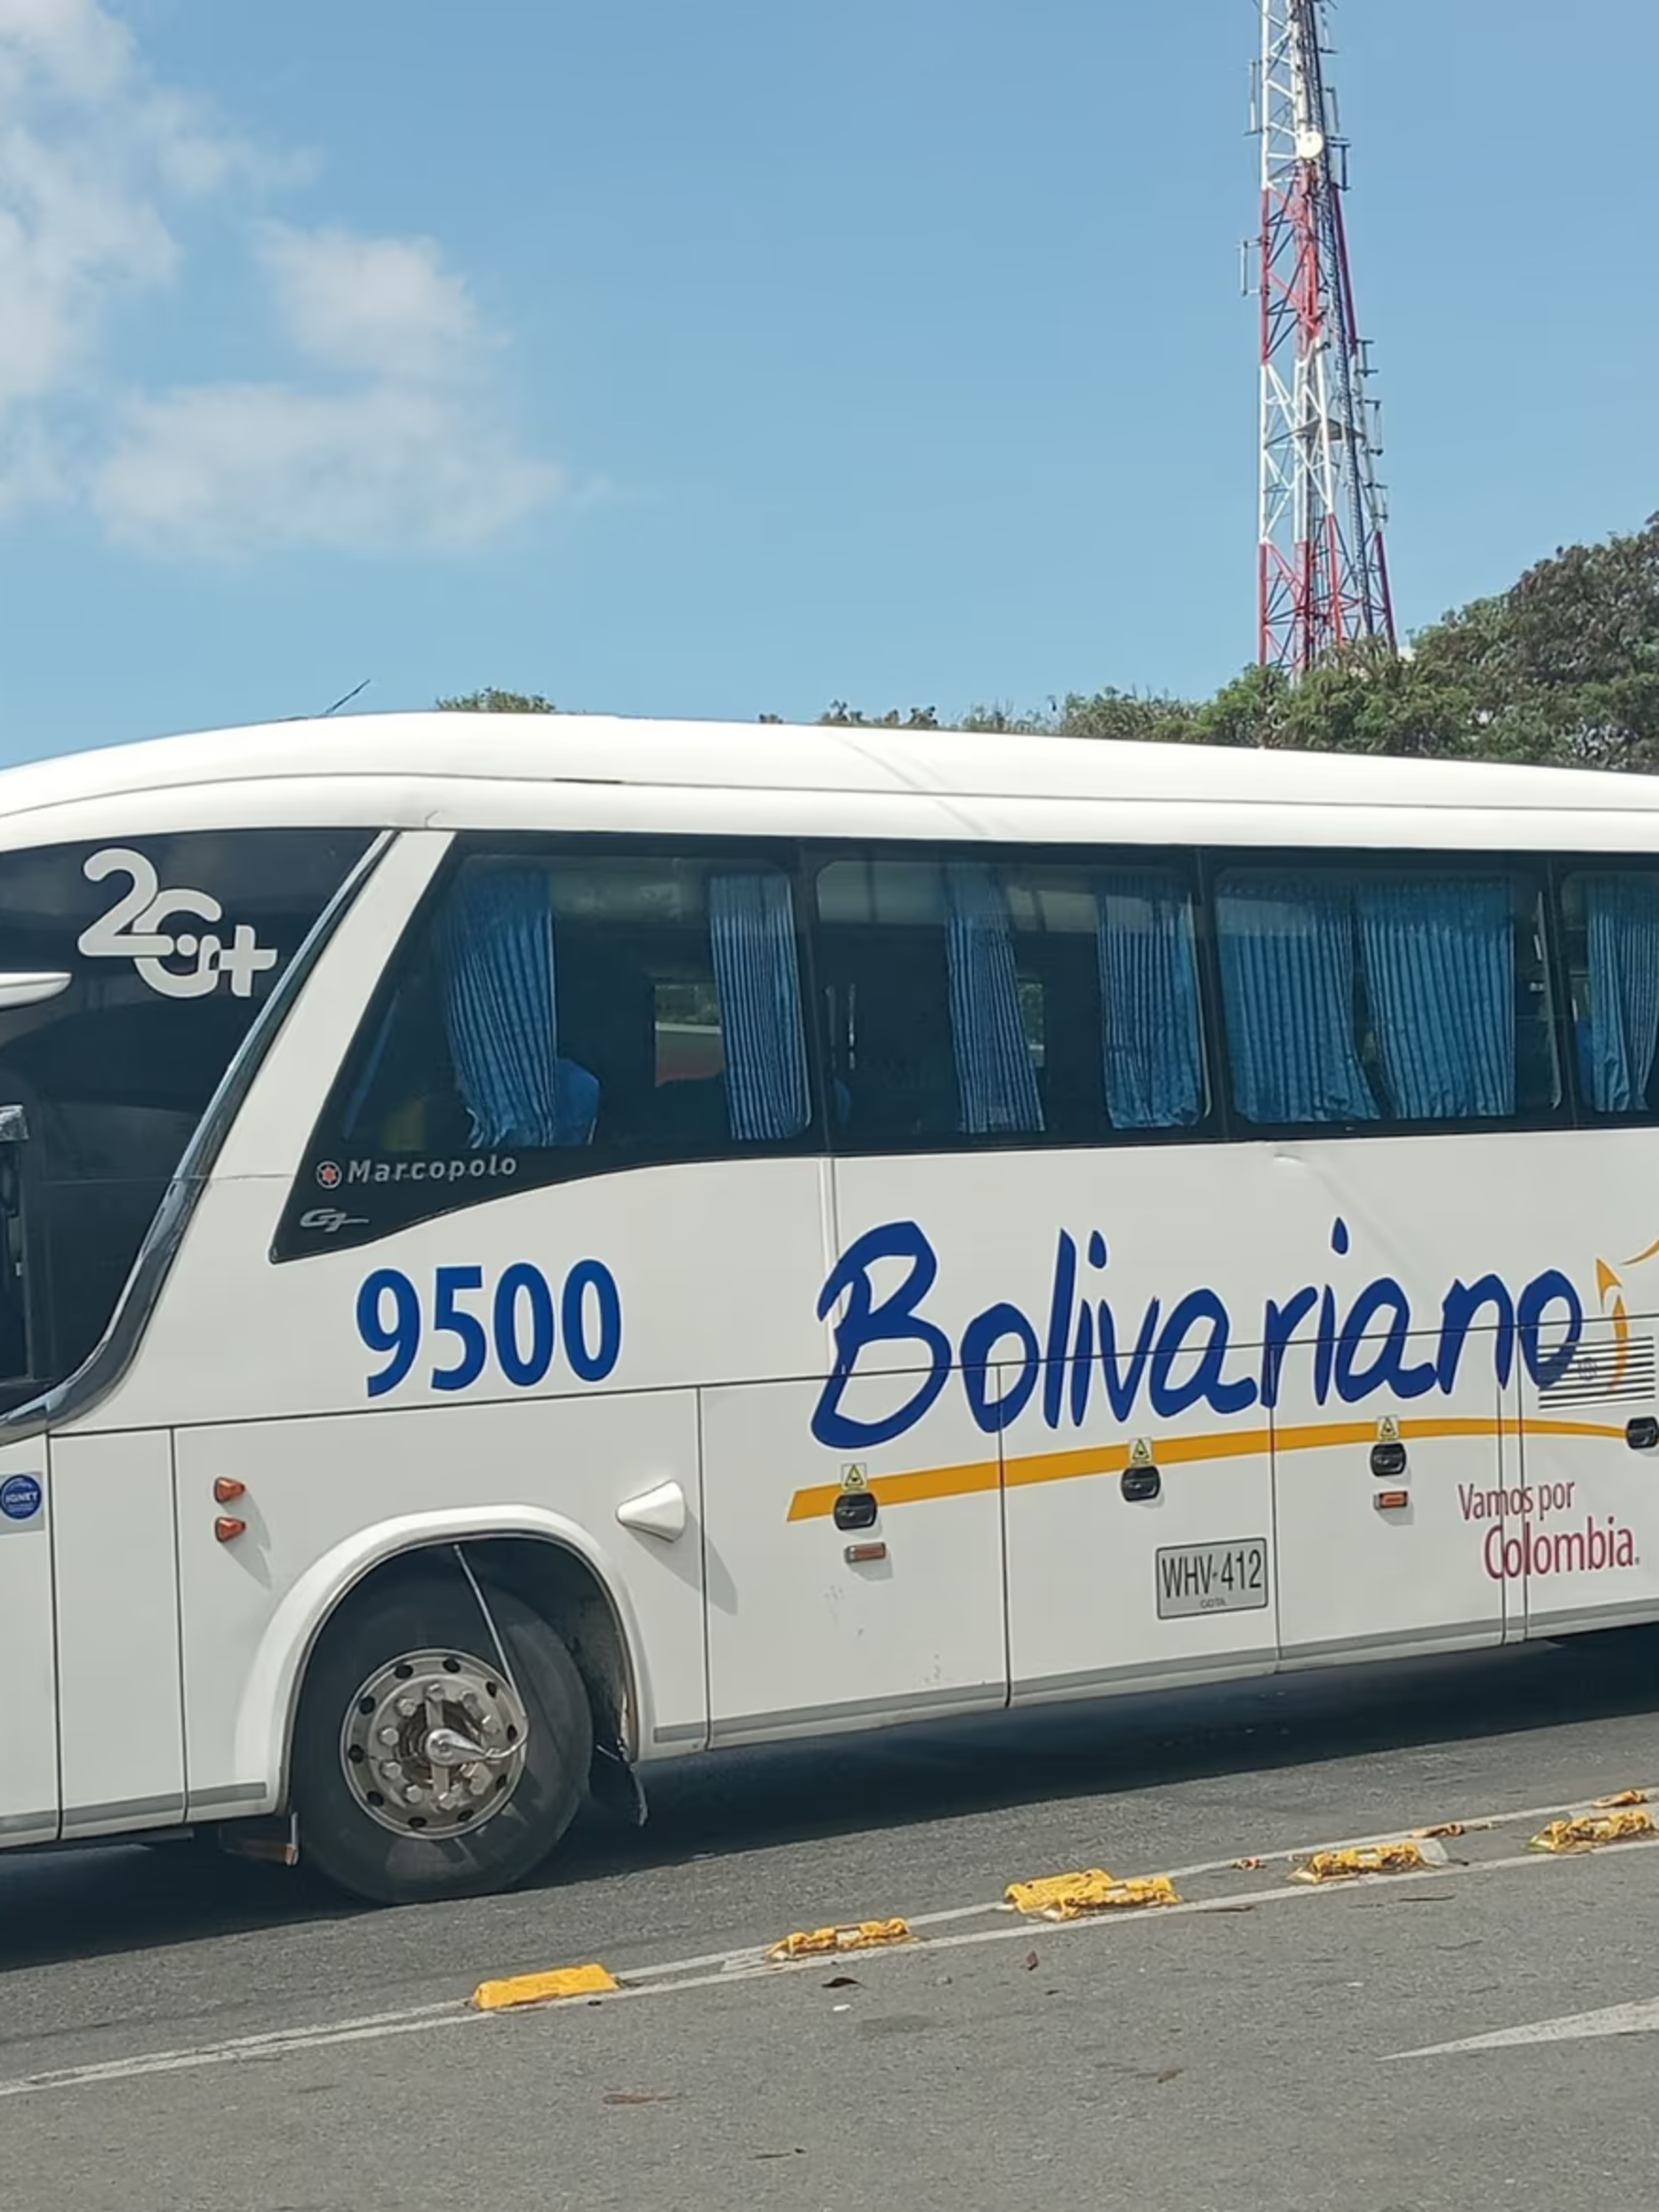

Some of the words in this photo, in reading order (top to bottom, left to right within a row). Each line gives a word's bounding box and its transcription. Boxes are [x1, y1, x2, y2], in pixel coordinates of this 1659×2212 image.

[347, 1154, 517, 1183] Marcopolo
[356, 1259, 621, 1397] 9500
[812, 1217, 1583, 1449] Bolivariano
[1458, 1483, 1533, 1521] Vamos
[1539, 1481, 1575, 1521] por
[1162, 1549, 1262, 1598] WHV-412
